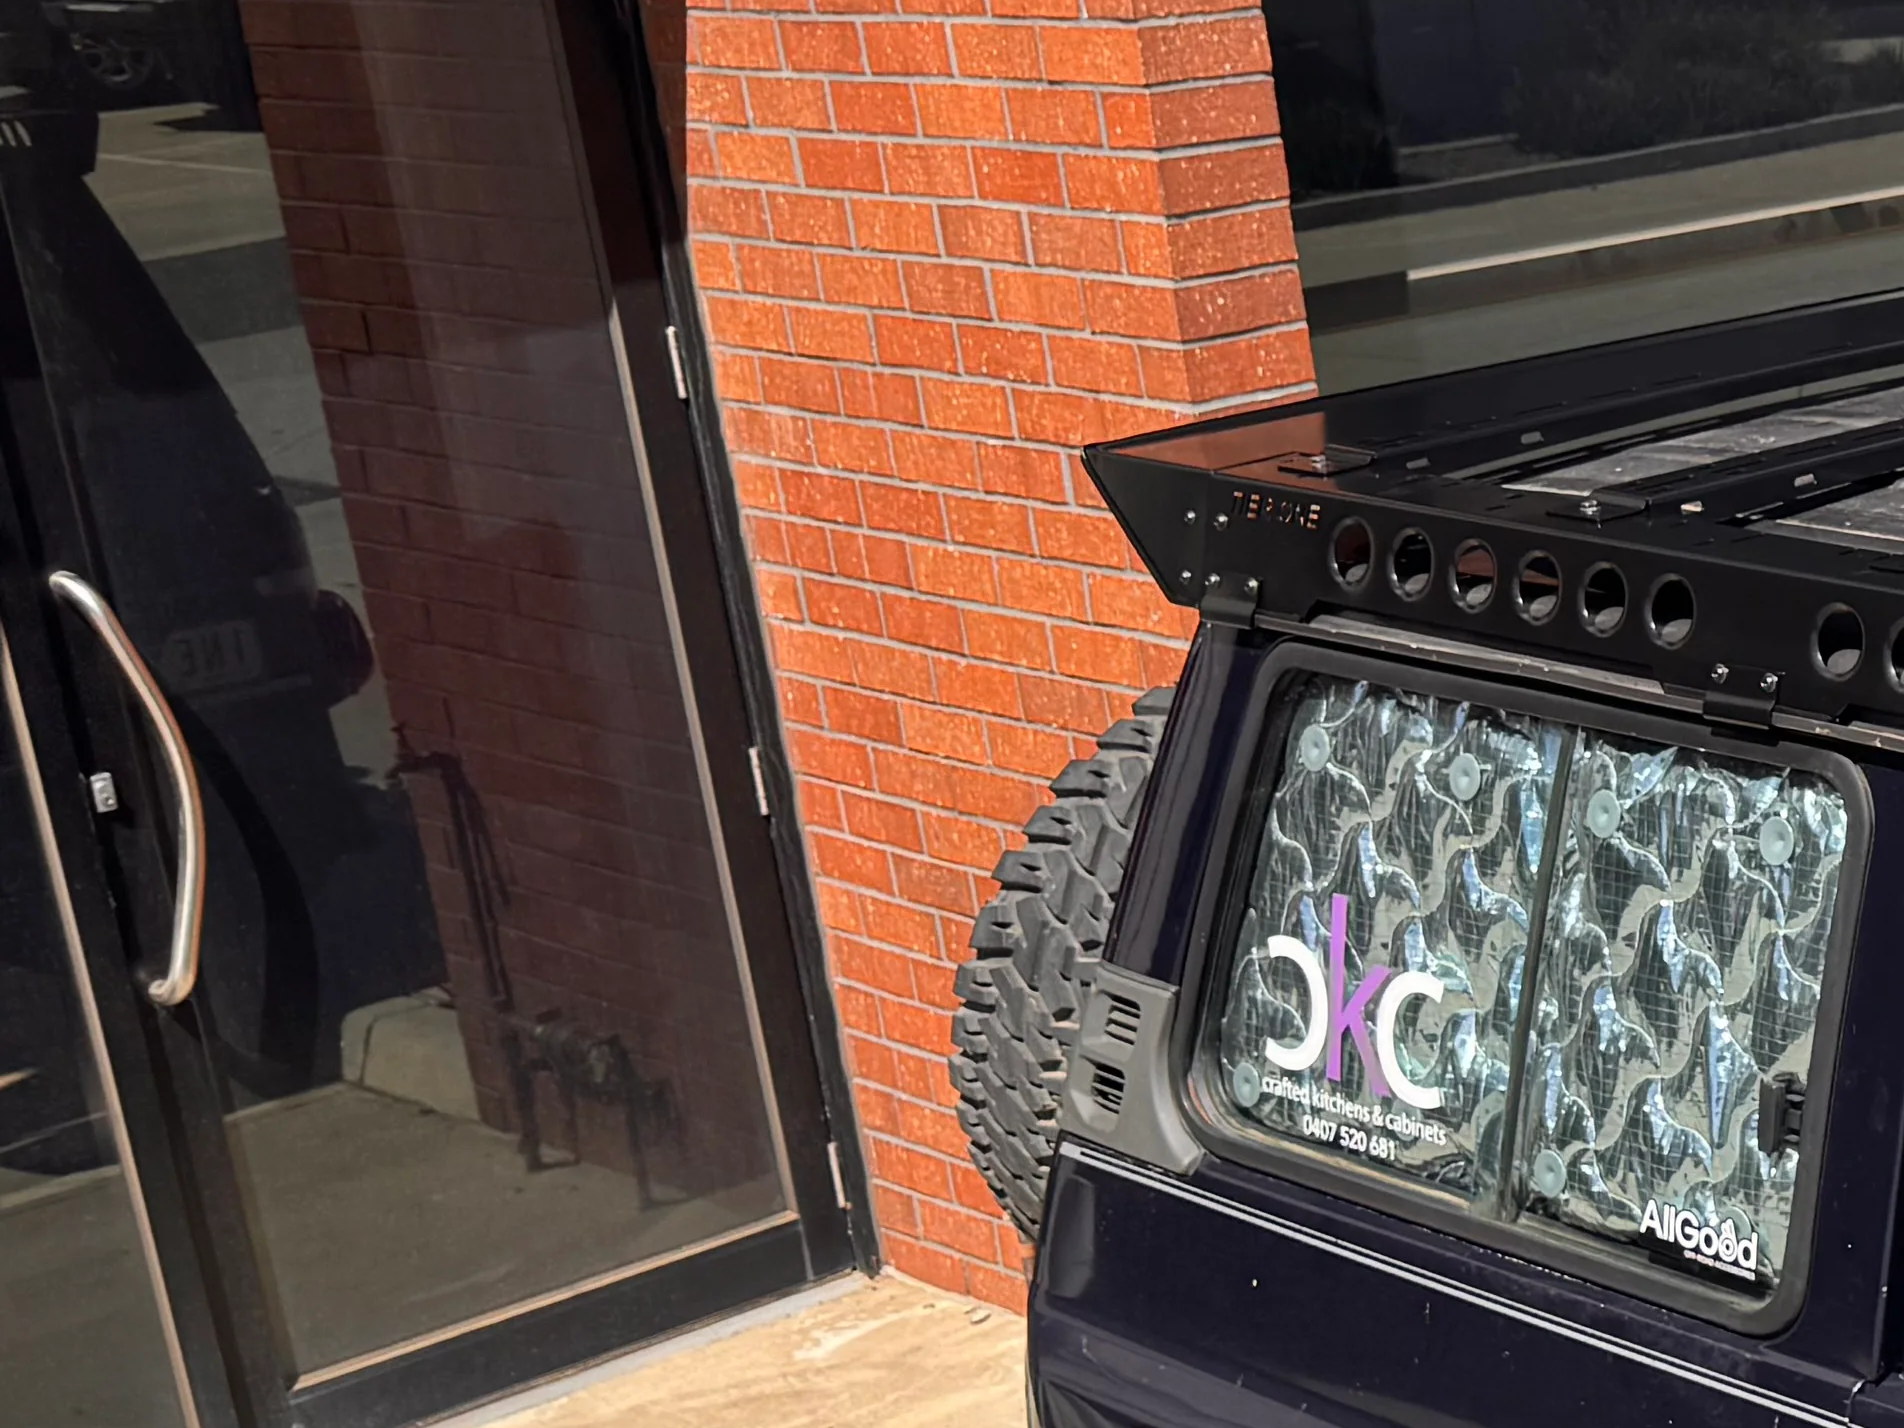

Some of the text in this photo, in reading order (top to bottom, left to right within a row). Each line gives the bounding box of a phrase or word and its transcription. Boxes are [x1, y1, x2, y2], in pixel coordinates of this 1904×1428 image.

[1262, 1076, 1447, 1146] crafted kitchens & cabinets
[1302, 1115, 1396, 1161] 0407 520 681
[1639, 1199, 1758, 1270] AllGood
